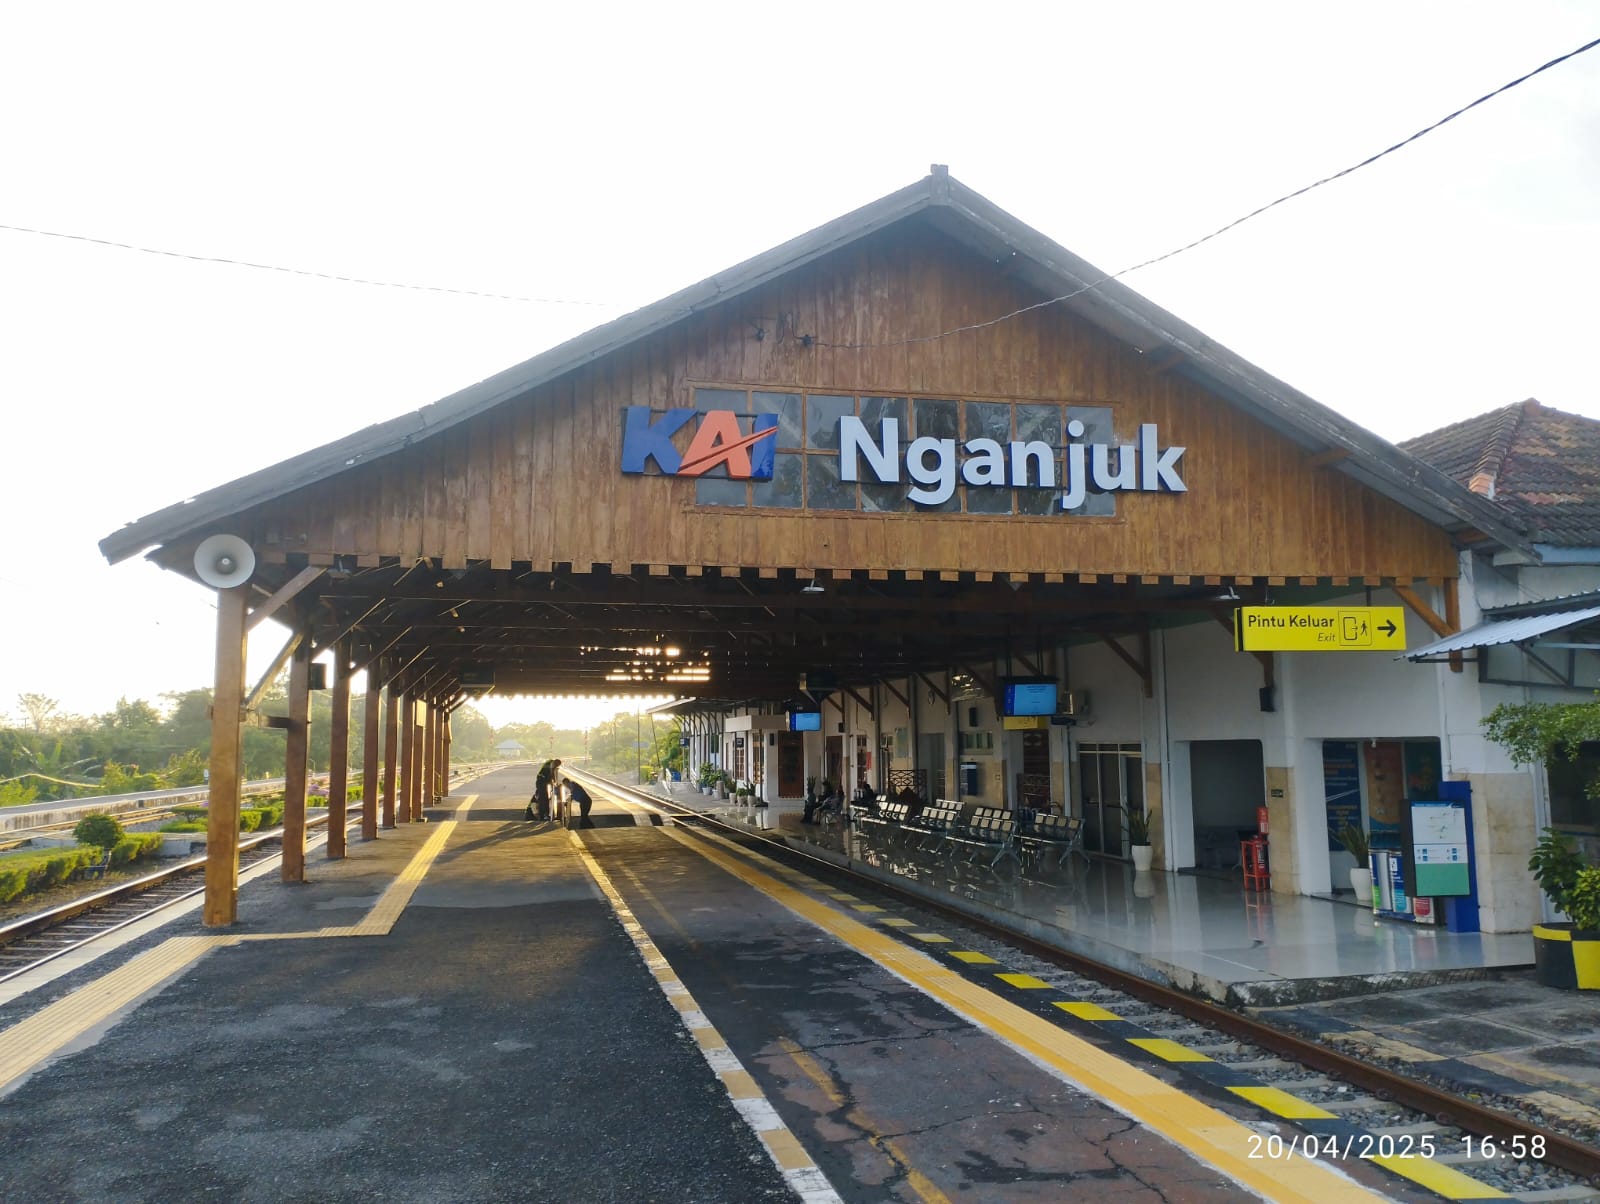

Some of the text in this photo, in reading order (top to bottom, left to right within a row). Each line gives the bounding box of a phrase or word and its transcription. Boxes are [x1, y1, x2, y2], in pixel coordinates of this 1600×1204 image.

[621, 404, 1188, 510] KAI Nganjuk
[1248, 614, 1335, 628] Pintu Keluar
[1317, 632, 1336, 642] Exit
